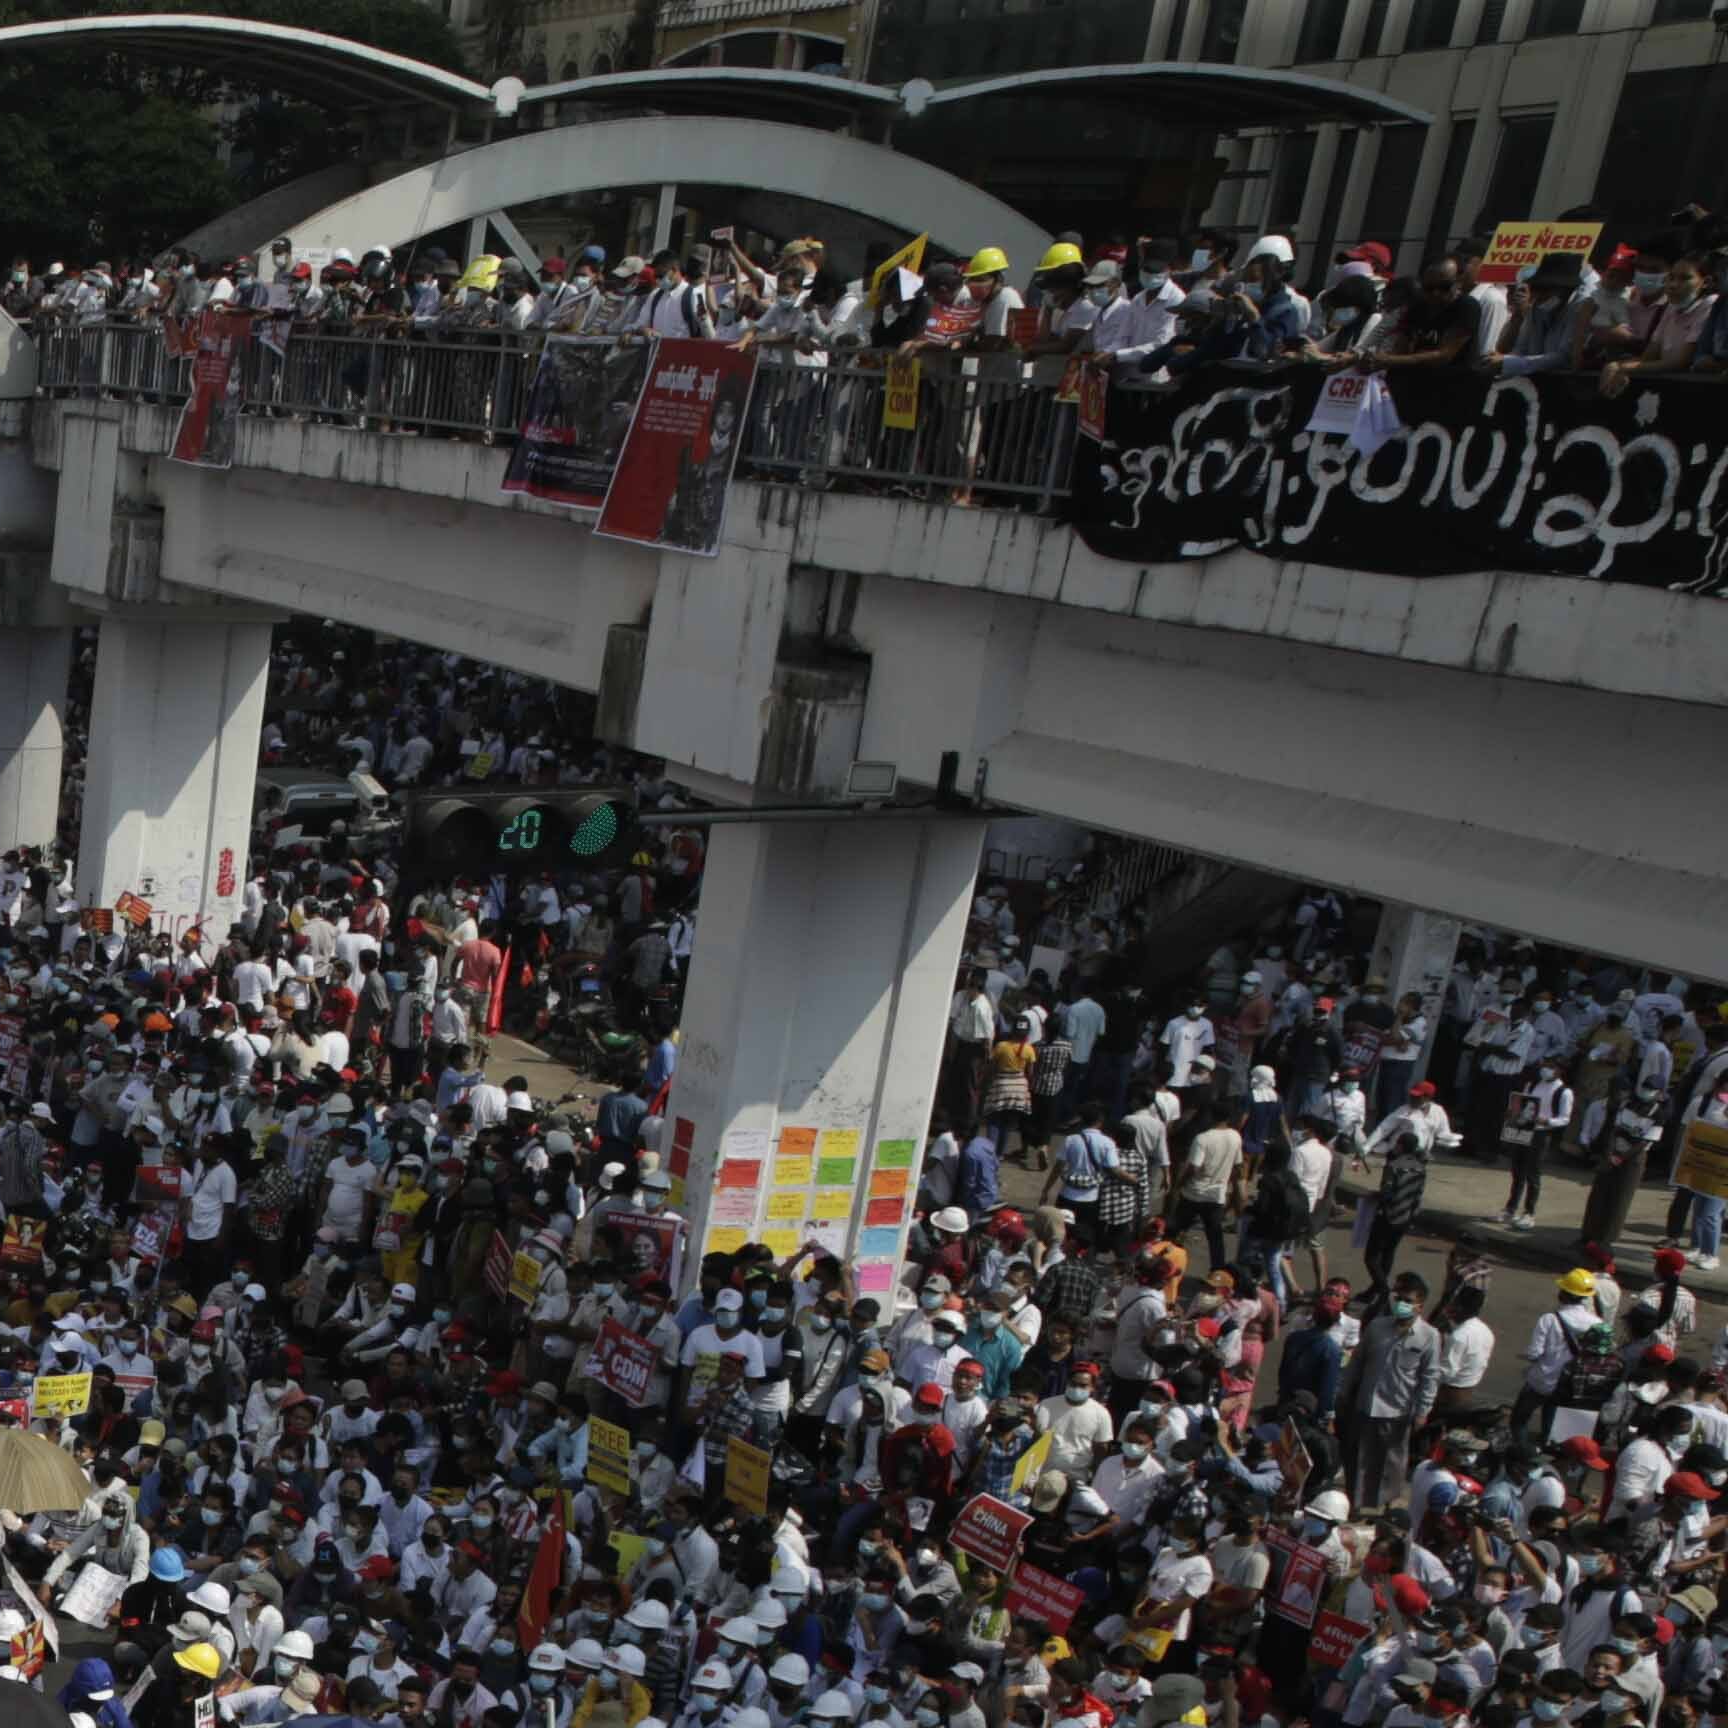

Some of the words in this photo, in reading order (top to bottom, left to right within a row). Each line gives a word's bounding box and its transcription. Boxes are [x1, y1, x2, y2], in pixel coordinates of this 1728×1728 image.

[1497, 234, 1530, 249] WE
[1533, 233, 1591, 249] NEED
[1489, 250, 1538, 262] YOUR
[499, 811, 541, 849] 20
[610, 1353, 649, 1388] CDM
[591, 1423, 626, 1451] FREE
[972, 1509, 1009, 1538] CHINA
